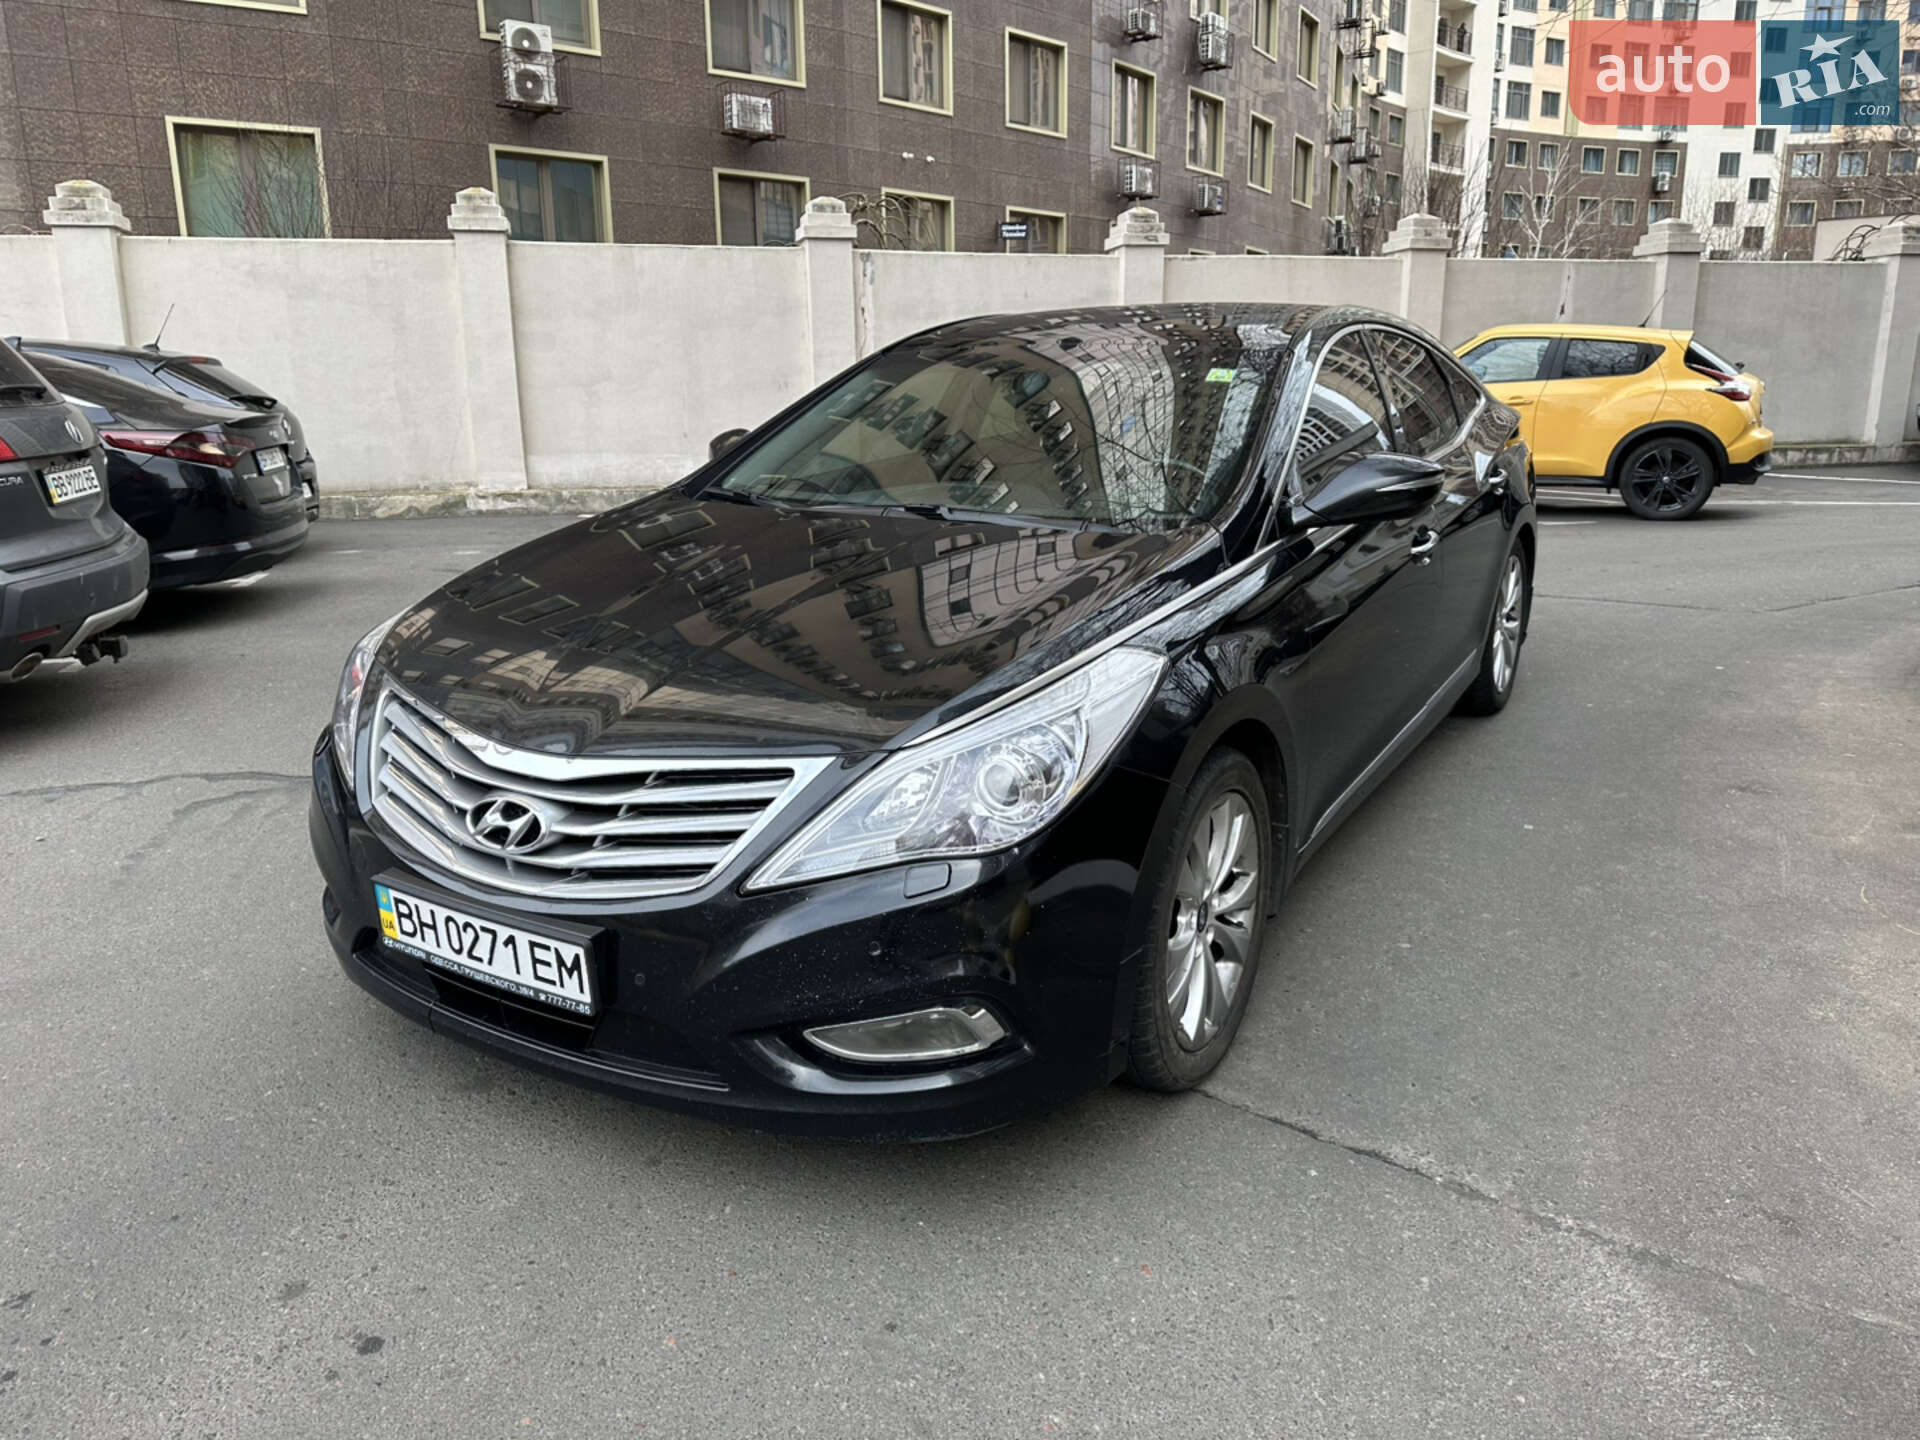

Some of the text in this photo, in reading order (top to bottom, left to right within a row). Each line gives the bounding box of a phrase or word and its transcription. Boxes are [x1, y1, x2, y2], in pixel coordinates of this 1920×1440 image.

[381, 917, 395, 932] UA
[393, 897, 585, 994] BH 0271 EM
